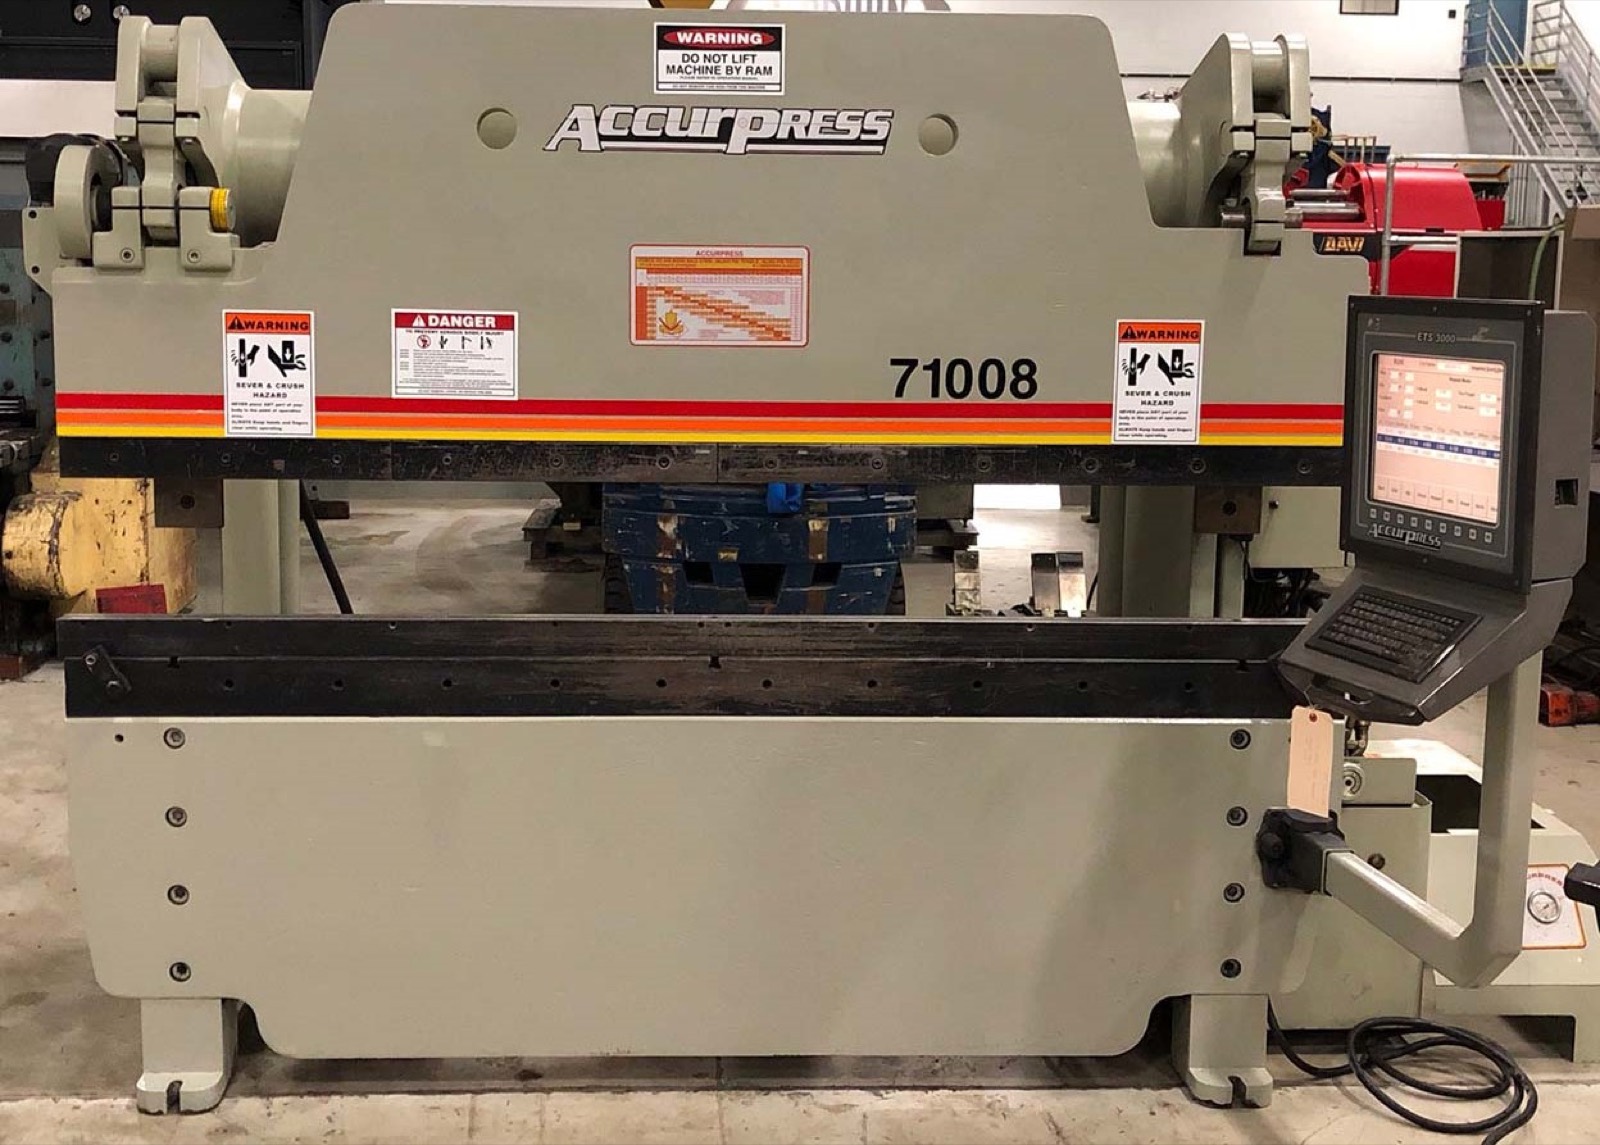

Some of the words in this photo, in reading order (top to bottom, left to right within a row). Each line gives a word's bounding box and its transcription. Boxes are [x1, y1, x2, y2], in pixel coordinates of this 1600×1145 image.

[676, 32, 763, 45] WARNING
[681, 53, 700, 64] DO
[703, 53, 728, 64] NOT
[731, 54, 757, 64] LIFT
[666, 65, 721, 76] MACHINE
[725, 66, 742, 76] BY
[745, 66, 773, 76] RAM
[243, 321, 309, 331] WARNING
[427, 315, 497, 328] DANGER
[1136, 330, 1199, 340] WARNING
[1417, 332, 1433, 342] ETS
[1435, 333, 1456, 343] 3000
[889, 357, 1038, 400] 71008
